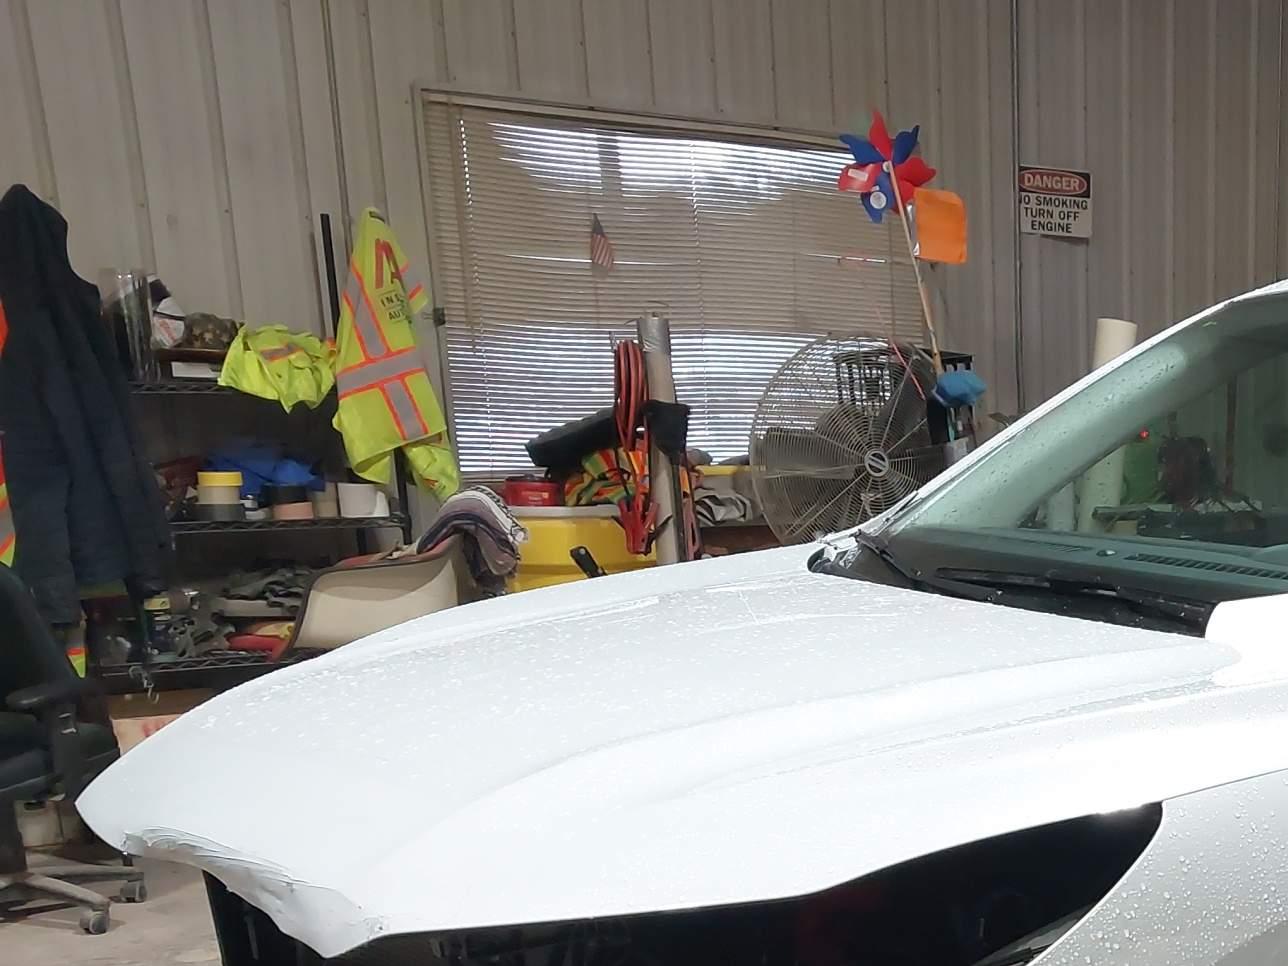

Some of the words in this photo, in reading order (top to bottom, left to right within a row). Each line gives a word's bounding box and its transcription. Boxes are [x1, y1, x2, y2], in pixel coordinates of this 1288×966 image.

[1024, 173, 1080, 191] DANGER
[1035, 196, 1088, 210] SMOKING
[1024, 207, 1054, 219] TURN
[1058, 210, 1080, 222] OFF
[1031, 220, 1073, 233] ENGINE
